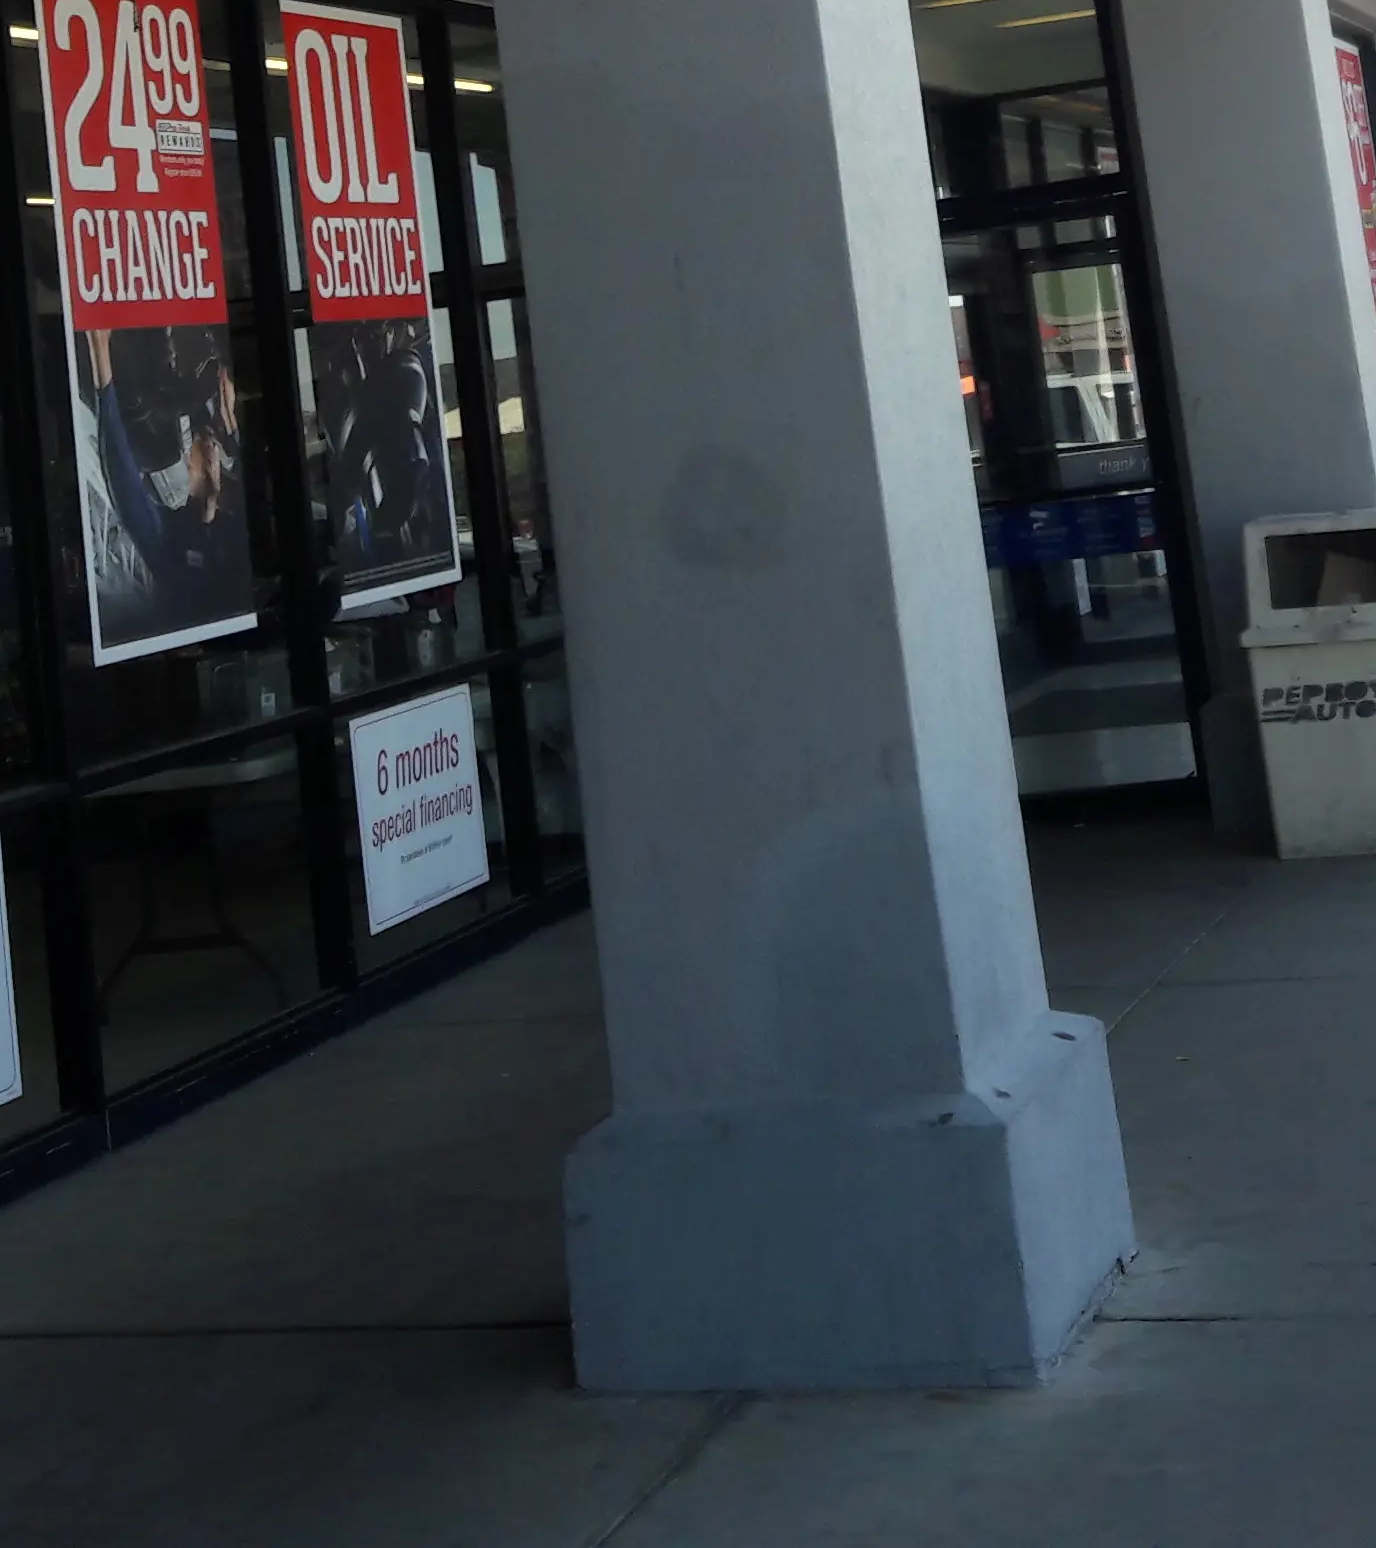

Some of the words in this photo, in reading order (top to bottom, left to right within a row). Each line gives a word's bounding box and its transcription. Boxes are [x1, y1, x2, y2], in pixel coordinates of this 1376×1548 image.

[294, 27, 401, 205] OIL
[72, 207, 216, 304] CHANGE
[311, 217, 423, 299] SERVICE
[377, 749, 389, 796] 6
[395, 727, 460, 789] months
[372, 804, 416, 853] special
[420, 783, 473, 829] financing
